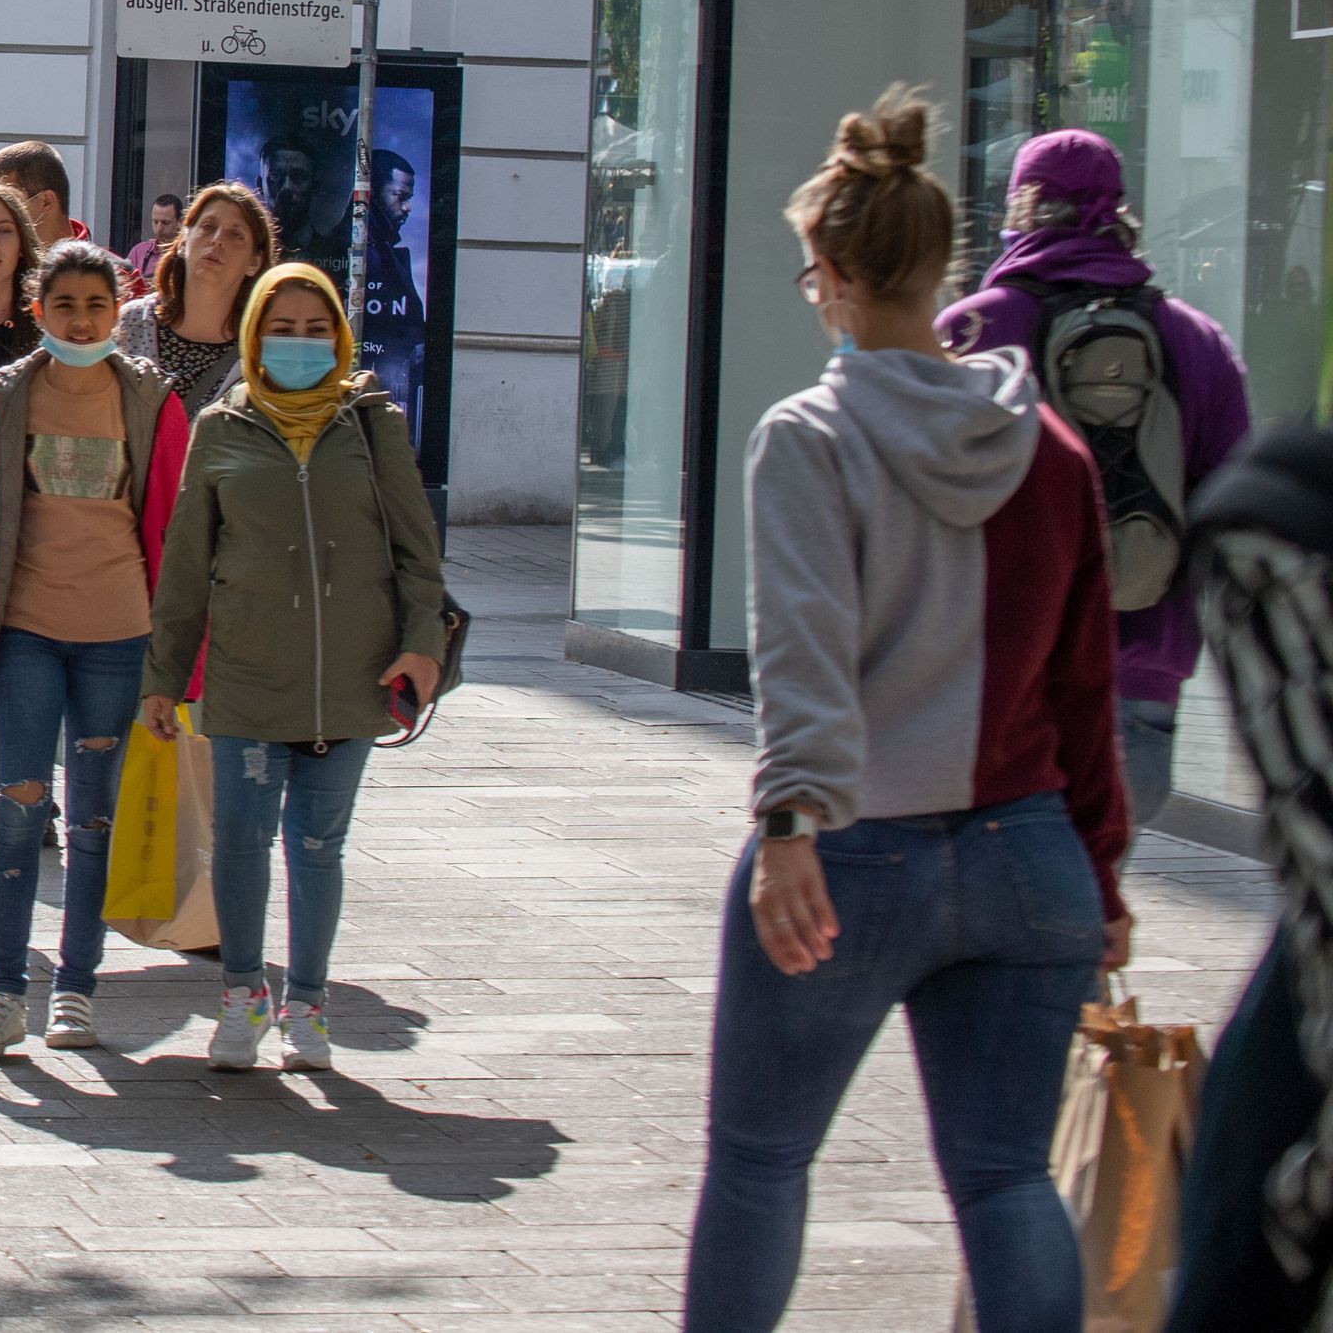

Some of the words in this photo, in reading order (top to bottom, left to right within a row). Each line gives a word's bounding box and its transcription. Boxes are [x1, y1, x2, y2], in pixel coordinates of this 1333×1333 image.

[201, 39, 215, 53] u.
[302, 101, 359, 136] sky
[362, 341, 385, 354] Sky.
